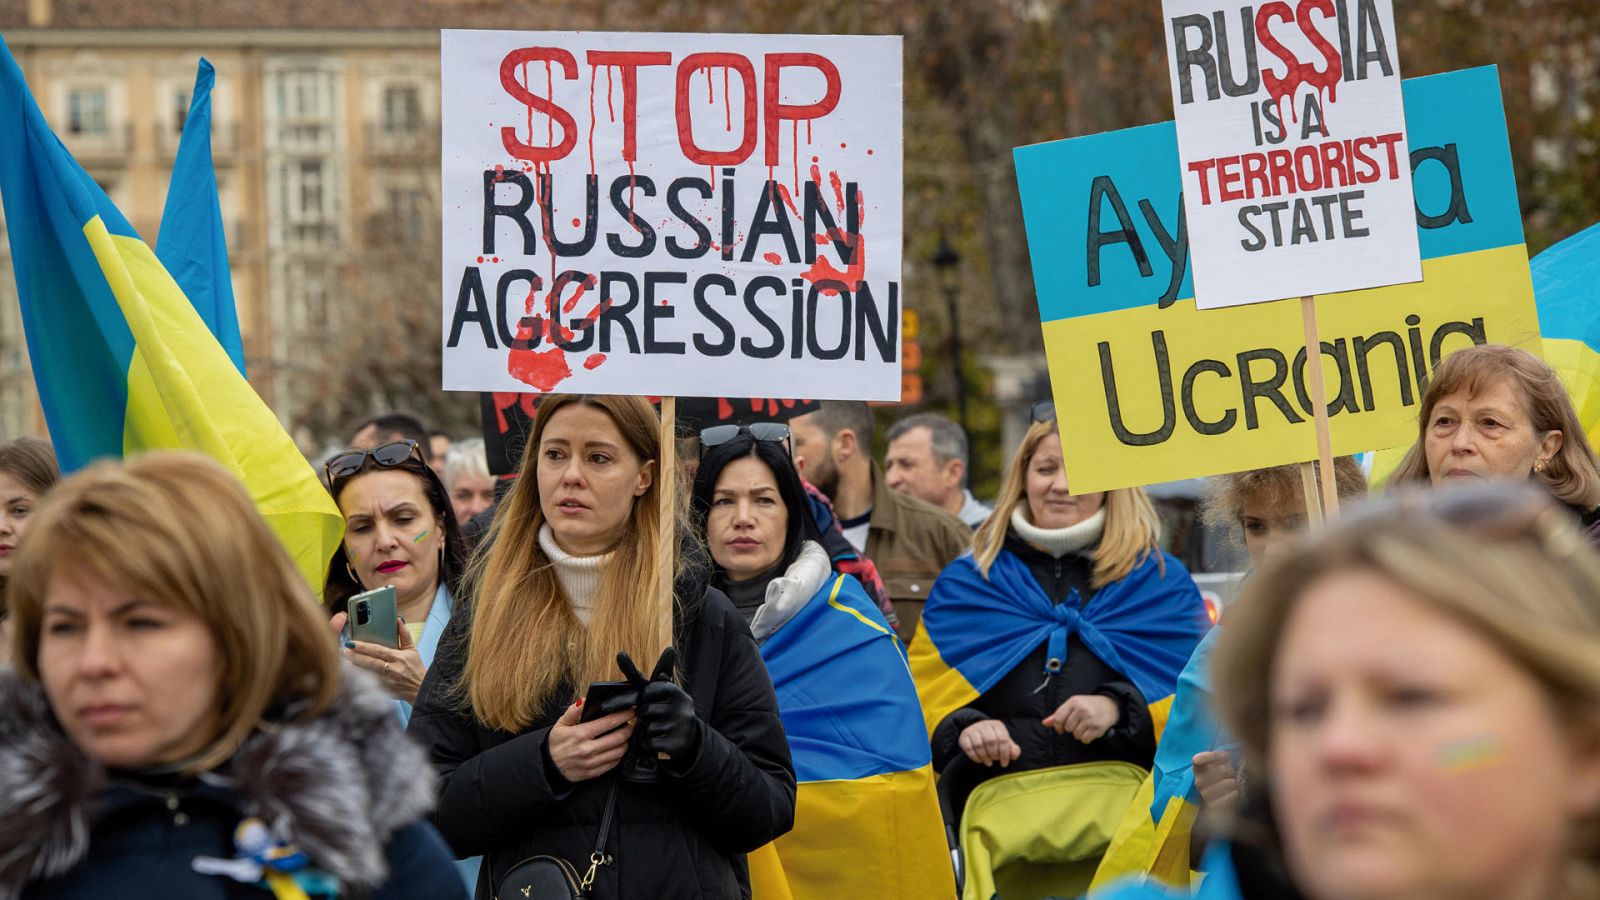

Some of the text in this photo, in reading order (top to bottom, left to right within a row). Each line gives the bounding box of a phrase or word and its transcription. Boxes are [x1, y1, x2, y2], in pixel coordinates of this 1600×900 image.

[1171, 0, 1395, 104] RUSSIA
[499, 47, 842, 167] STOP
[1251, 93, 1329, 146] IS A
[1188, 132, 1403, 206] TERRORIST
[1238, 190, 1370, 252] STATE
